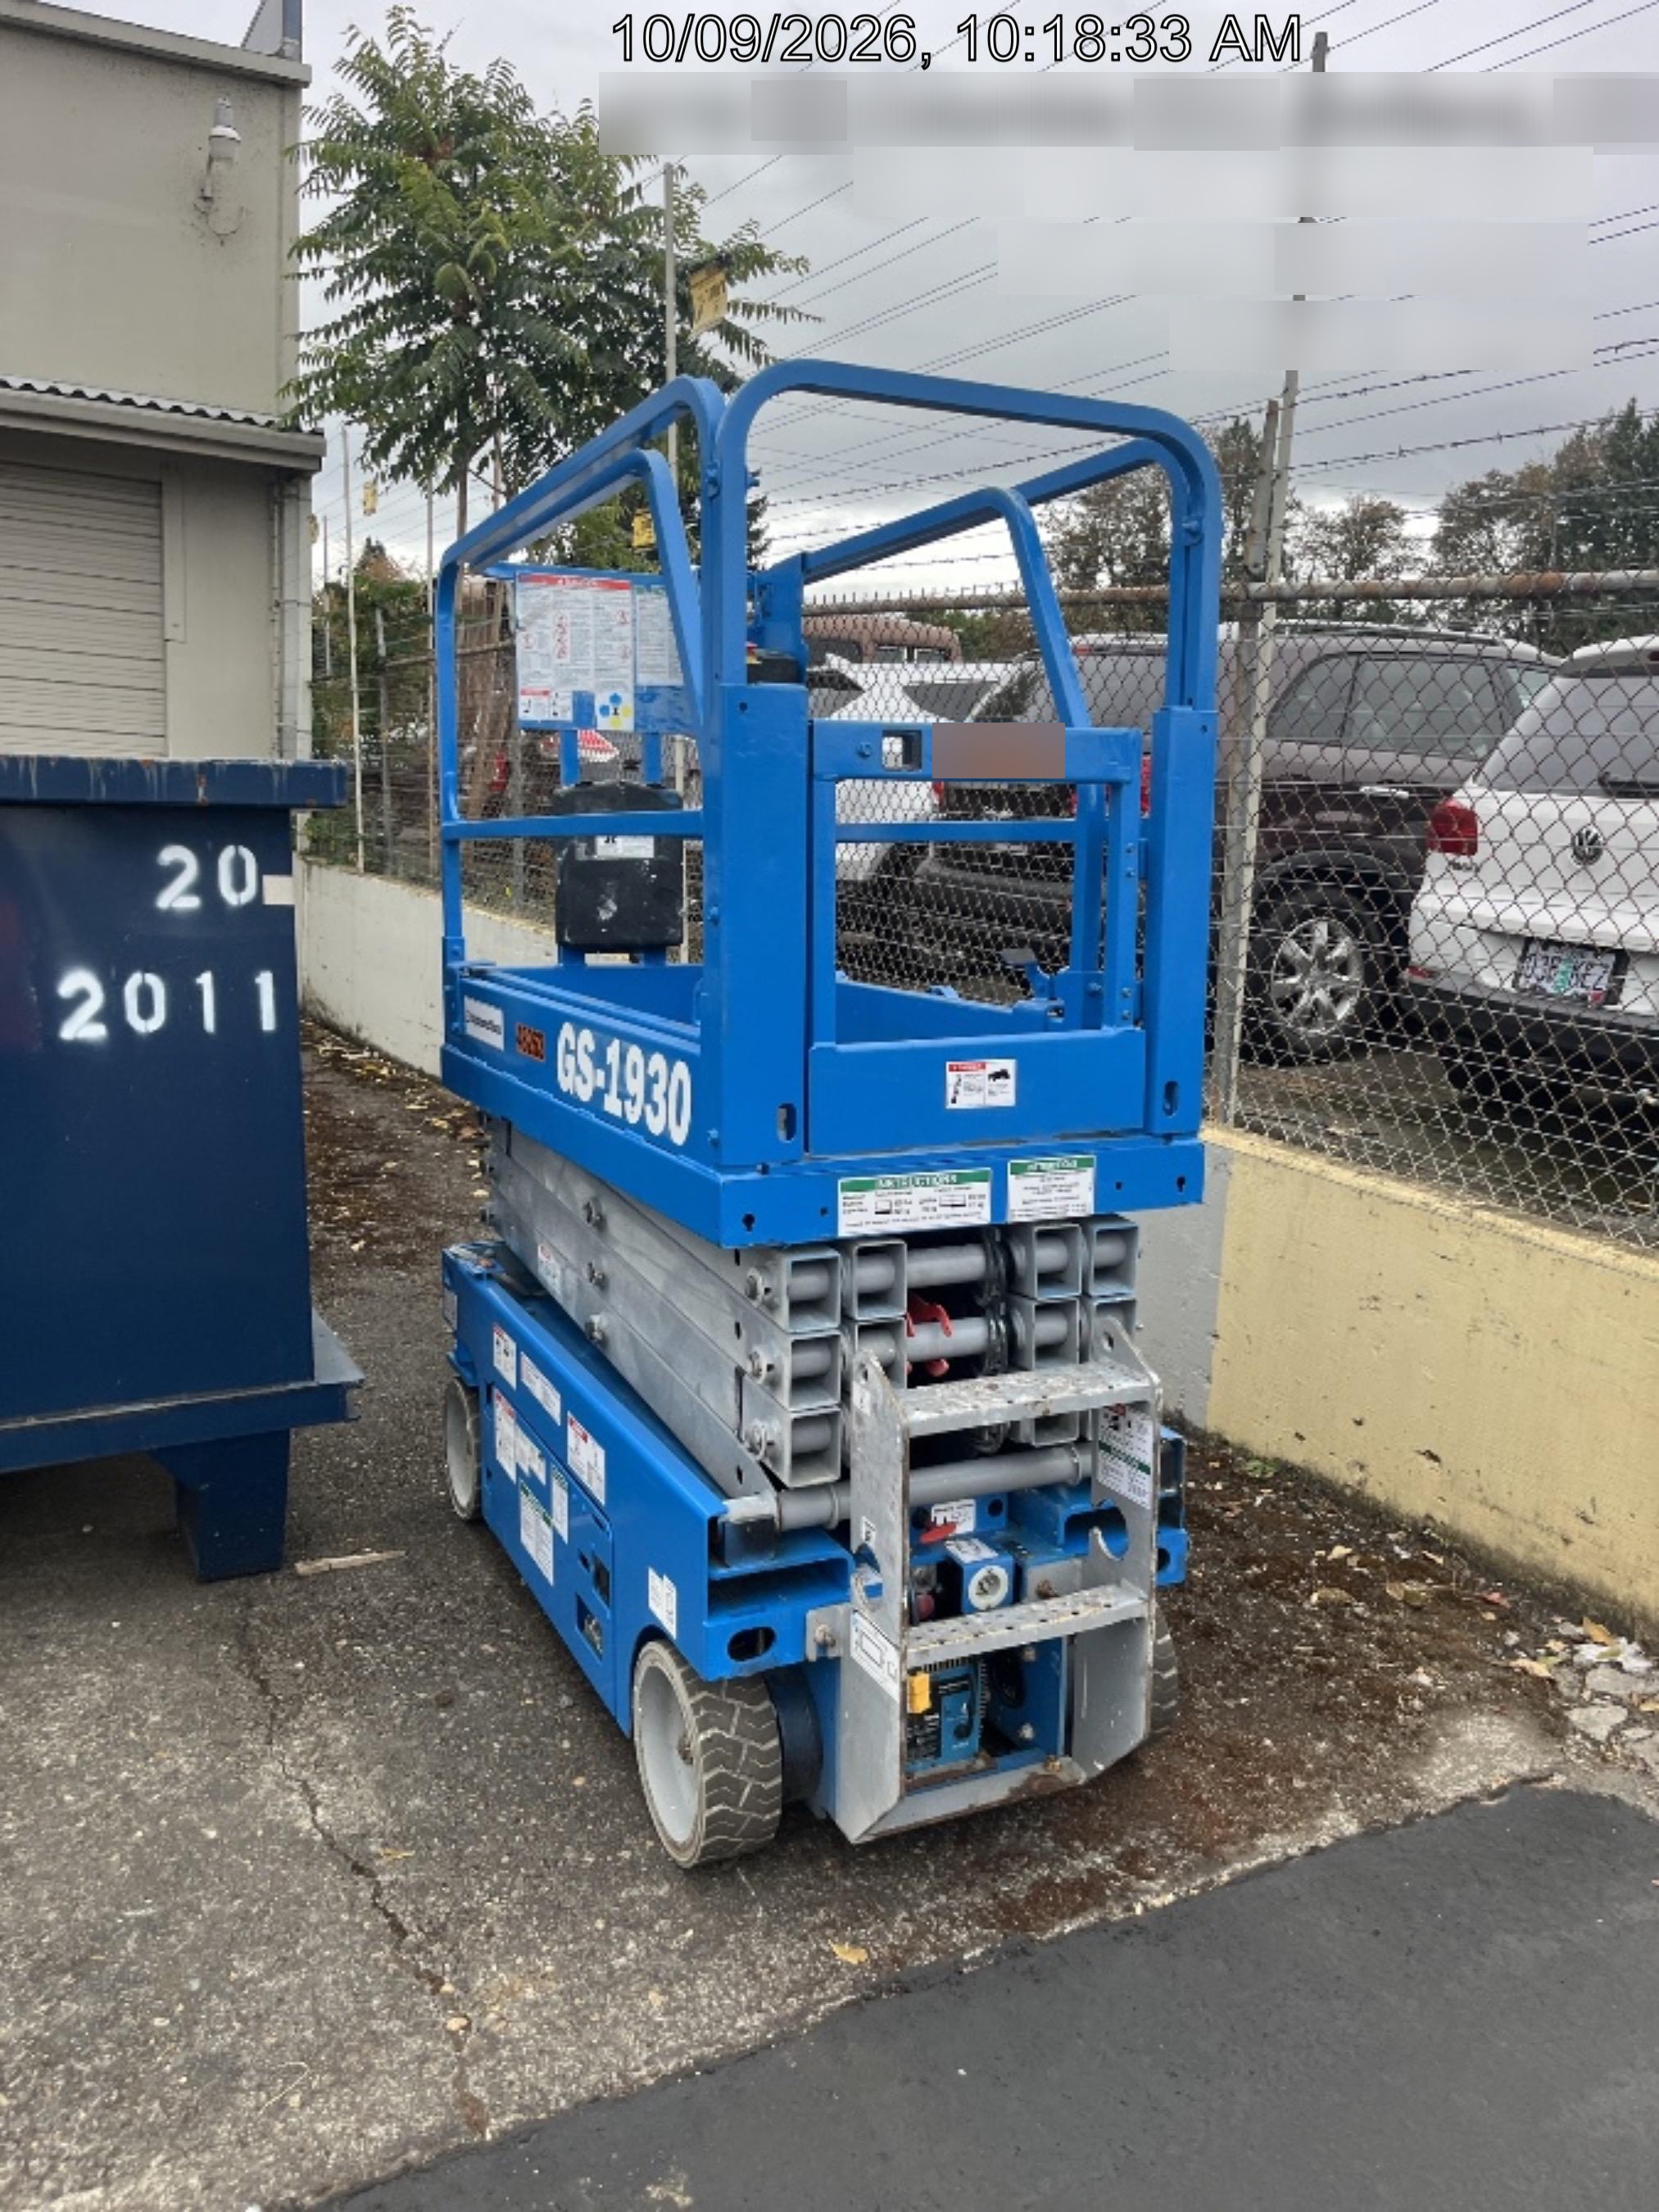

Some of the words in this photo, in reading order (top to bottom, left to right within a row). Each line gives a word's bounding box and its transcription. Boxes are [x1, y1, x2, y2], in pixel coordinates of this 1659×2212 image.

[156, 844, 257, 908] 20
[57, 968, 277, 1040] 2011
[557, 1022, 691, 1146] GS-1930
